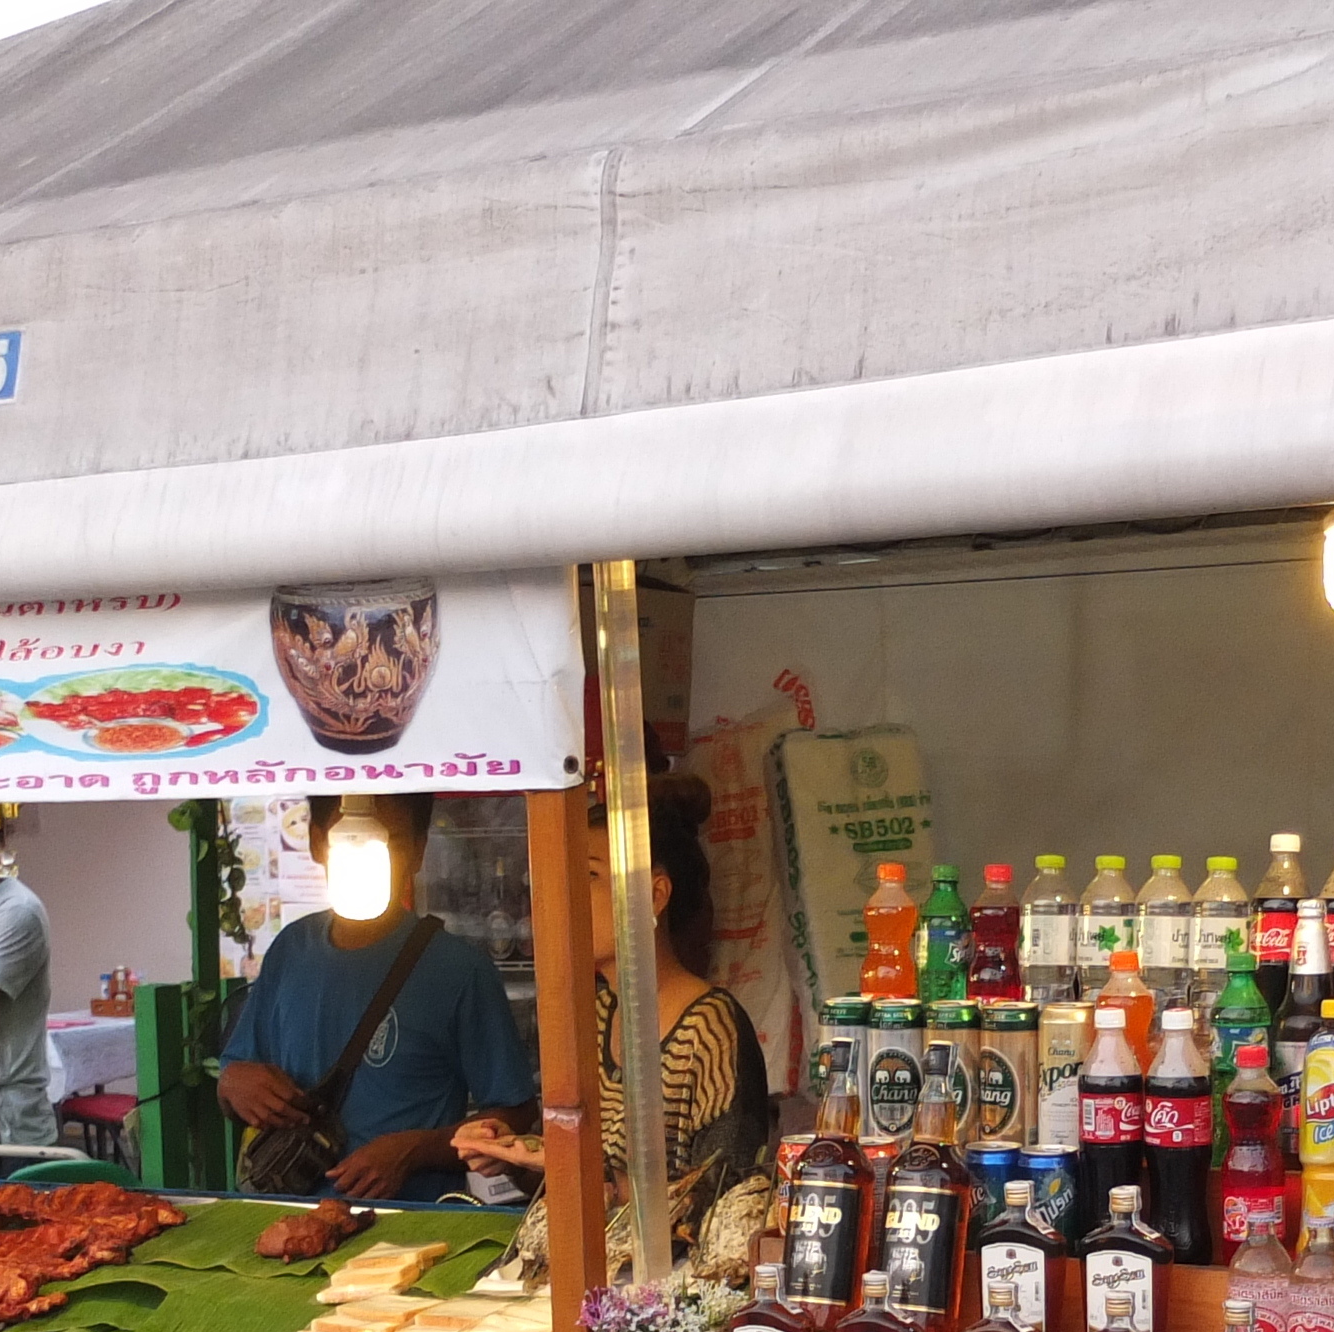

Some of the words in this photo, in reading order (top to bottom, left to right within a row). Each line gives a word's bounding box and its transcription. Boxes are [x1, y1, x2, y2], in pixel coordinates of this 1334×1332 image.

[132, 754, 522, 796] ถูกหลักอนามัย
[843, 816, 916, 840] SB502
[1039, 1062, 1083, 1091] xpor
[980, 1087, 1012, 1106] ang
[1314, 1122, 1334, 1143] Ice
